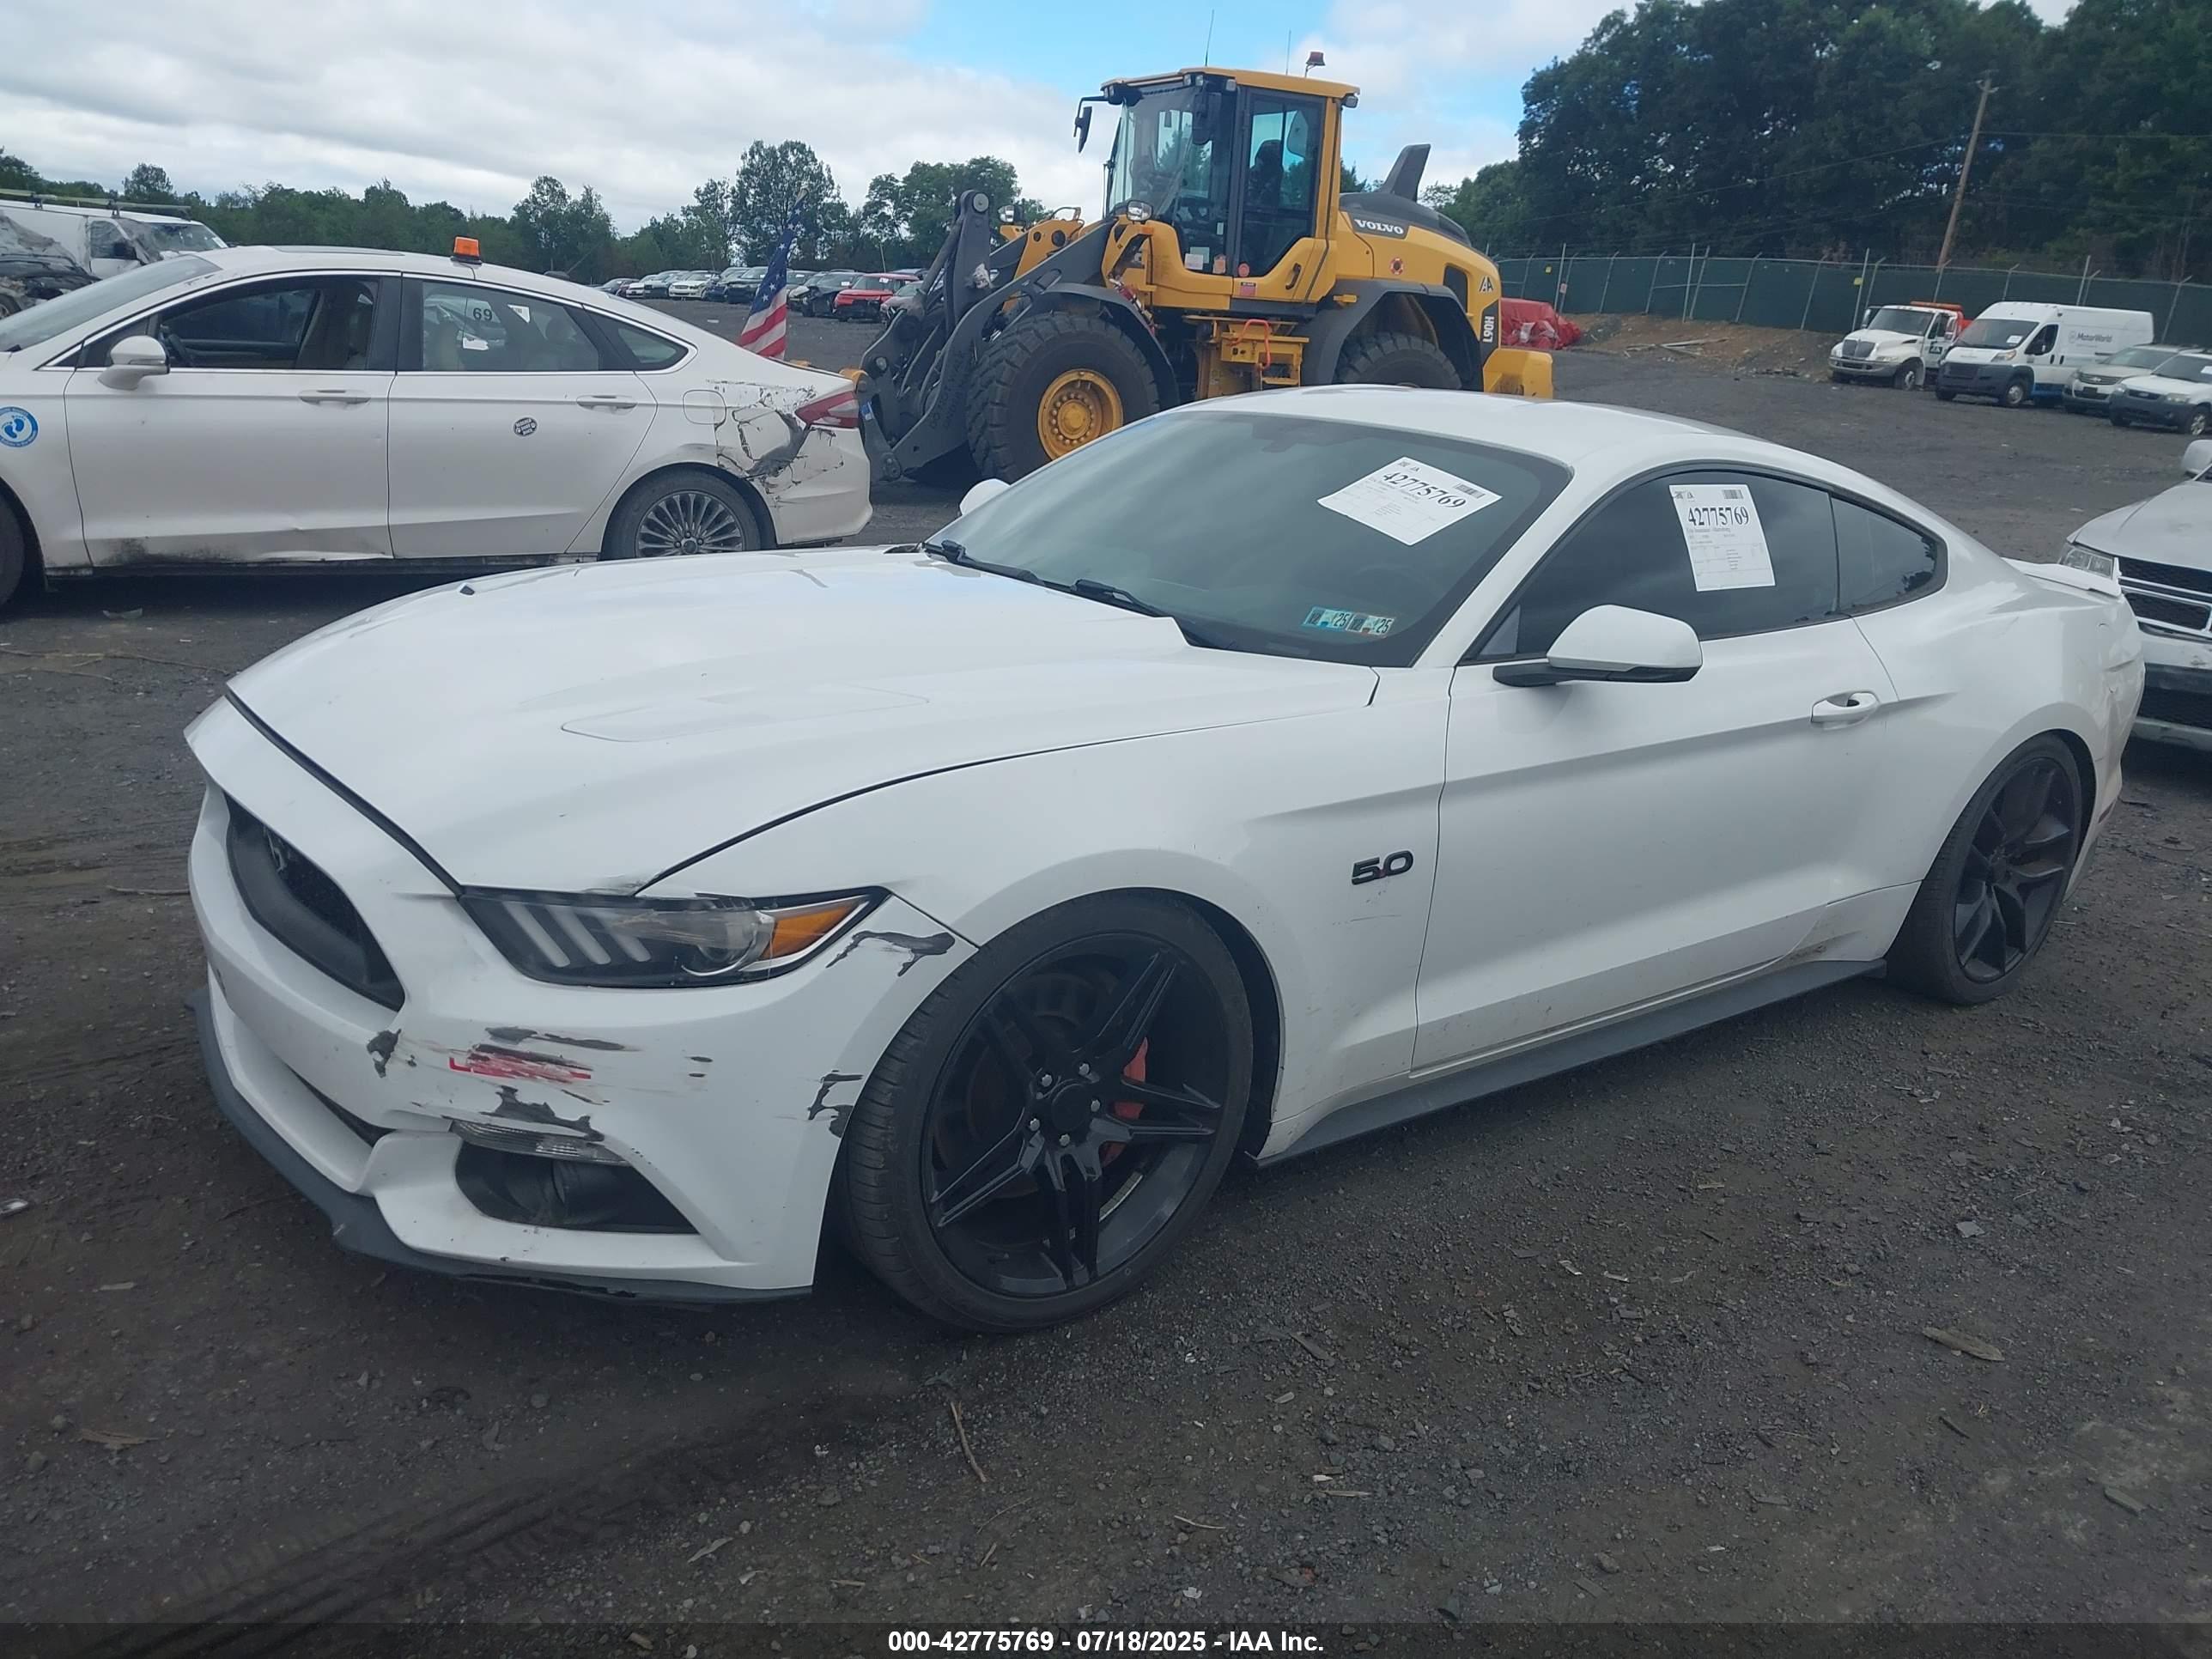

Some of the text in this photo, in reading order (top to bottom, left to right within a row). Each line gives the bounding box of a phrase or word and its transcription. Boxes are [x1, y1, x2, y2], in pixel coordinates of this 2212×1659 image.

[1354, 219, 1404, 234] VOLVO
[473, 307, 493, 321] 69
[1482, 315, 1495, 343] L90H
[1383, 472, 1467, 508] 42775769
[1687, 506, 1749, 526] 42775769
[1334, 613, 1350, 627] 25
[1376, 619, 1392, 634] 25
